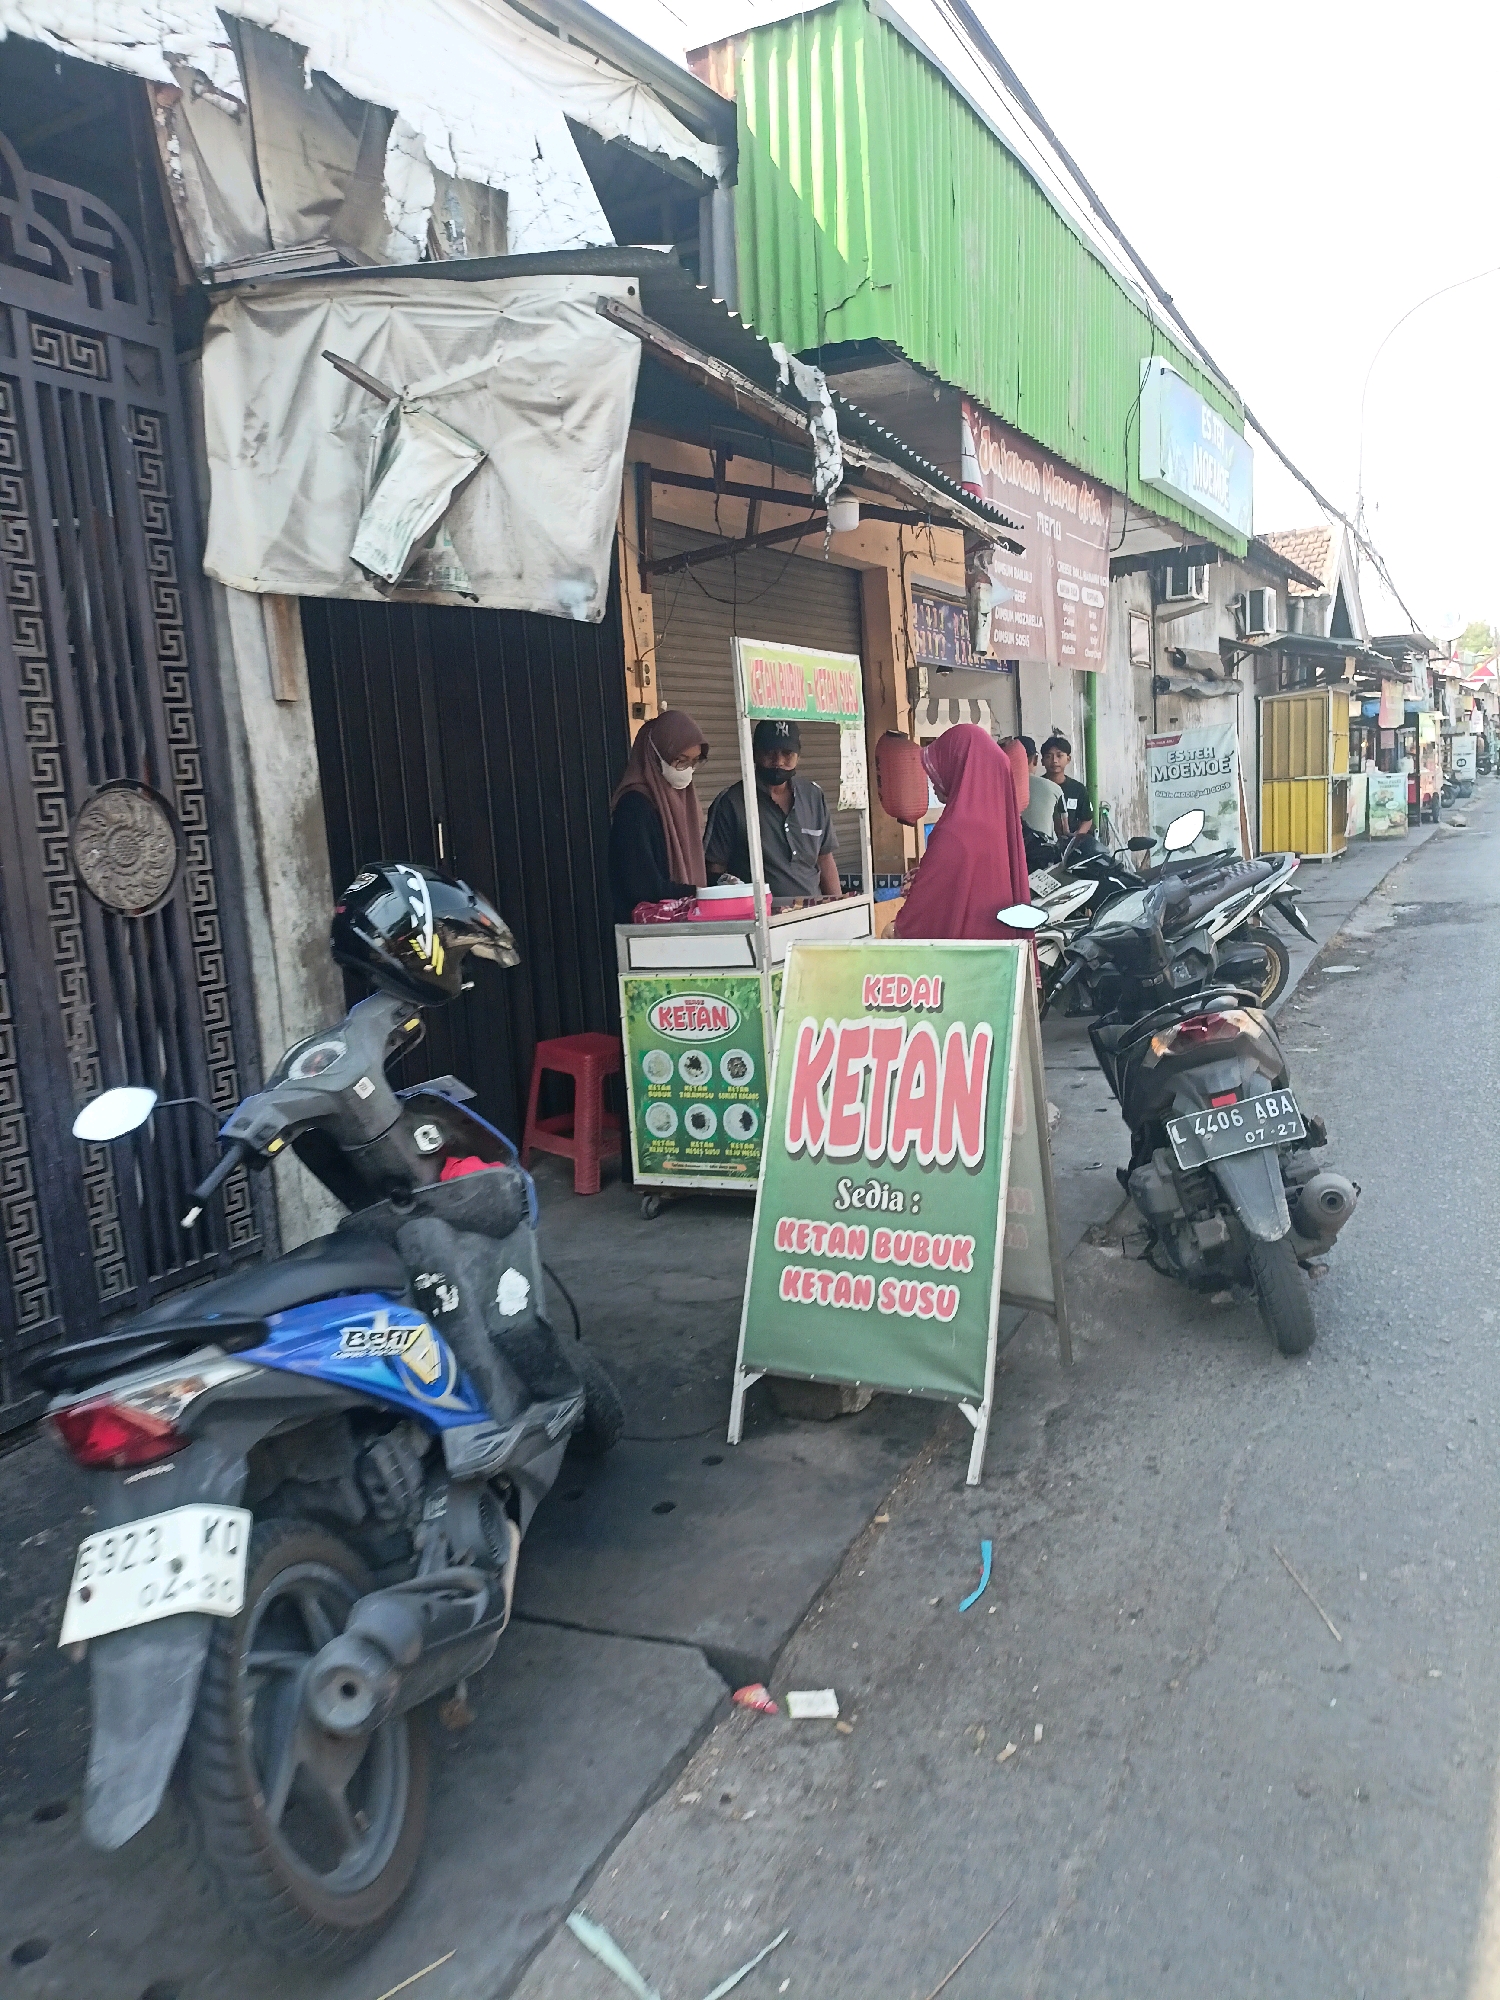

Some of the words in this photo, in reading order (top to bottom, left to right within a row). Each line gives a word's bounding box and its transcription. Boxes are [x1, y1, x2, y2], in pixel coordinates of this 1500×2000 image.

[1151, 757, 1231, 783] MOEMOE
[862, 974, 945, 1012] KEDAI
[657, 1005, 730, 1031] KETAN
[785, 1016, 993, 1170] KETAN
[1171, 1125, 1187, 1145] L
[1194, 1108, 1244, 1136] 4406
[1255, 1095, 1294, 1120] ABA
[834, 1178, 905, 1213] Sedia
[774, 1217, 869, 1260] KETAN
[871, 1225, 975, 1274] BUBUK
[779, 1265, 875, 1312] KETAN
[877, 1275, 960, 1323] SUSU
